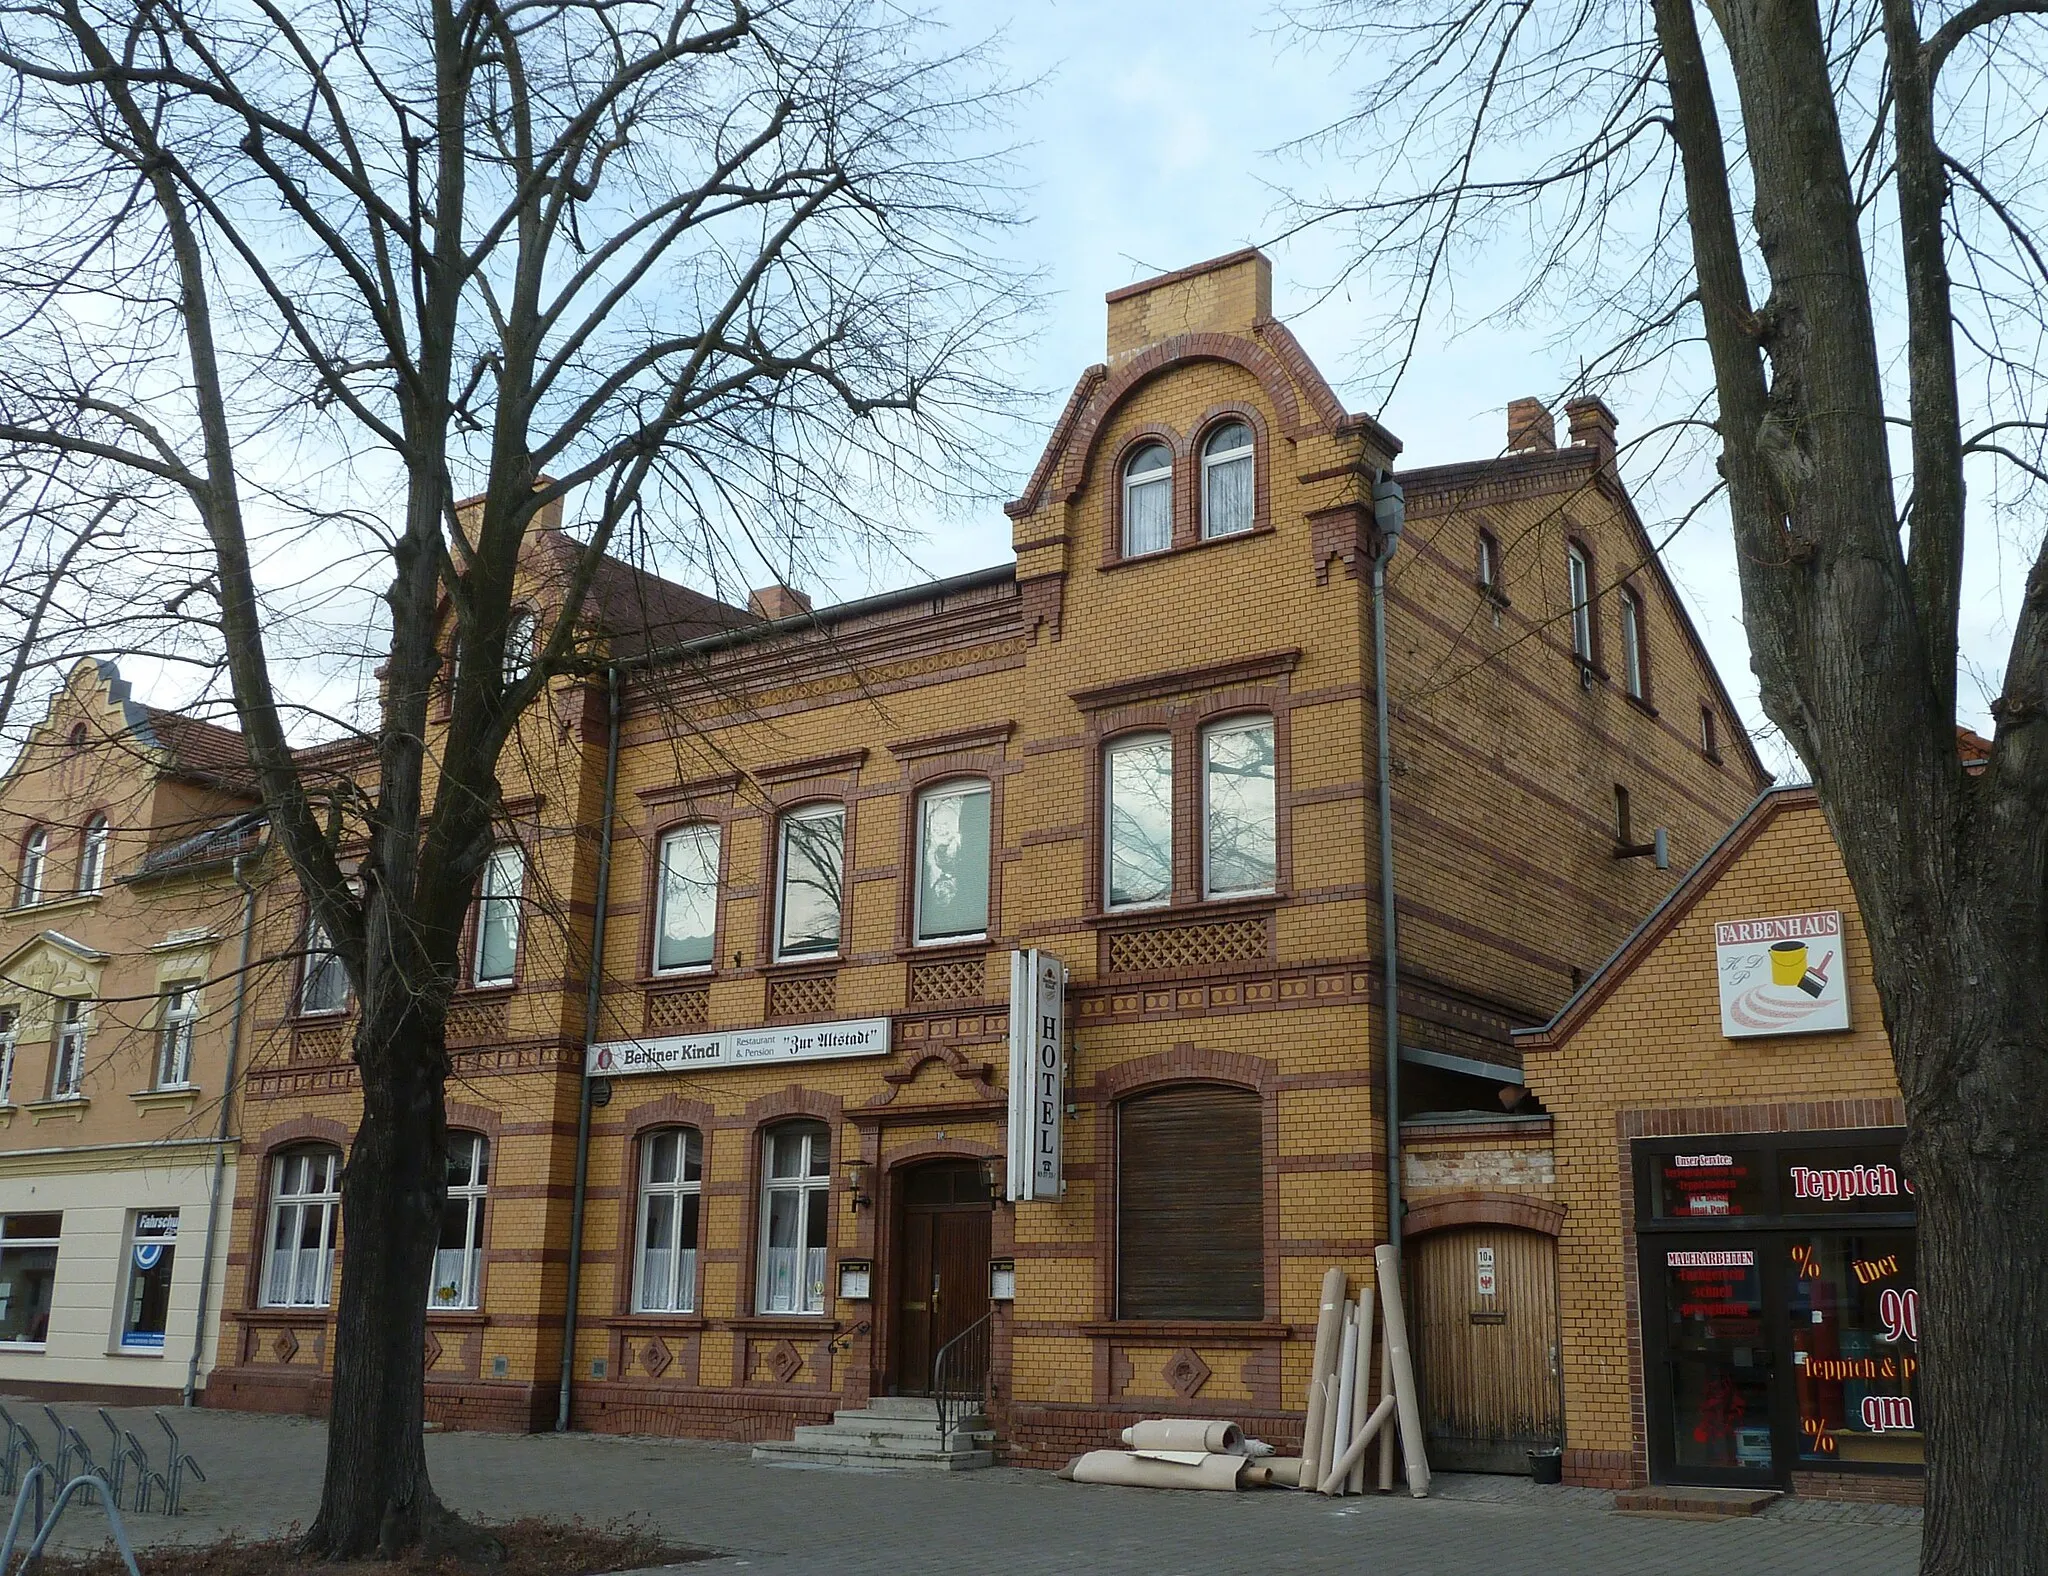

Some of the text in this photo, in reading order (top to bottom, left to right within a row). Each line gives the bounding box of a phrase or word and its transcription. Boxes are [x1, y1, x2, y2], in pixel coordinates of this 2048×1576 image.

[1718, 913, 1838, 943] FARBENHAUS
[736, 1034, 777, 1047] Restaurant
[624, 1042, 721, 1065] Berliner Kindl
[735, 1047, 775, 1059] & Pension
[1042, 1015, 1057, 1155] HOTEL
[1674, 1154, 1733, 1167] Unser Service:
[1790, 1163, 1899, 1202] Teppich
[1667, 1251, 1754, 1267] MALERARBEITEN
[1804, 1356, 1876, 1380] Teppich
[1880, 1356, 1897, 1378] &
[1861, 1395, 1915, 1434] qm
